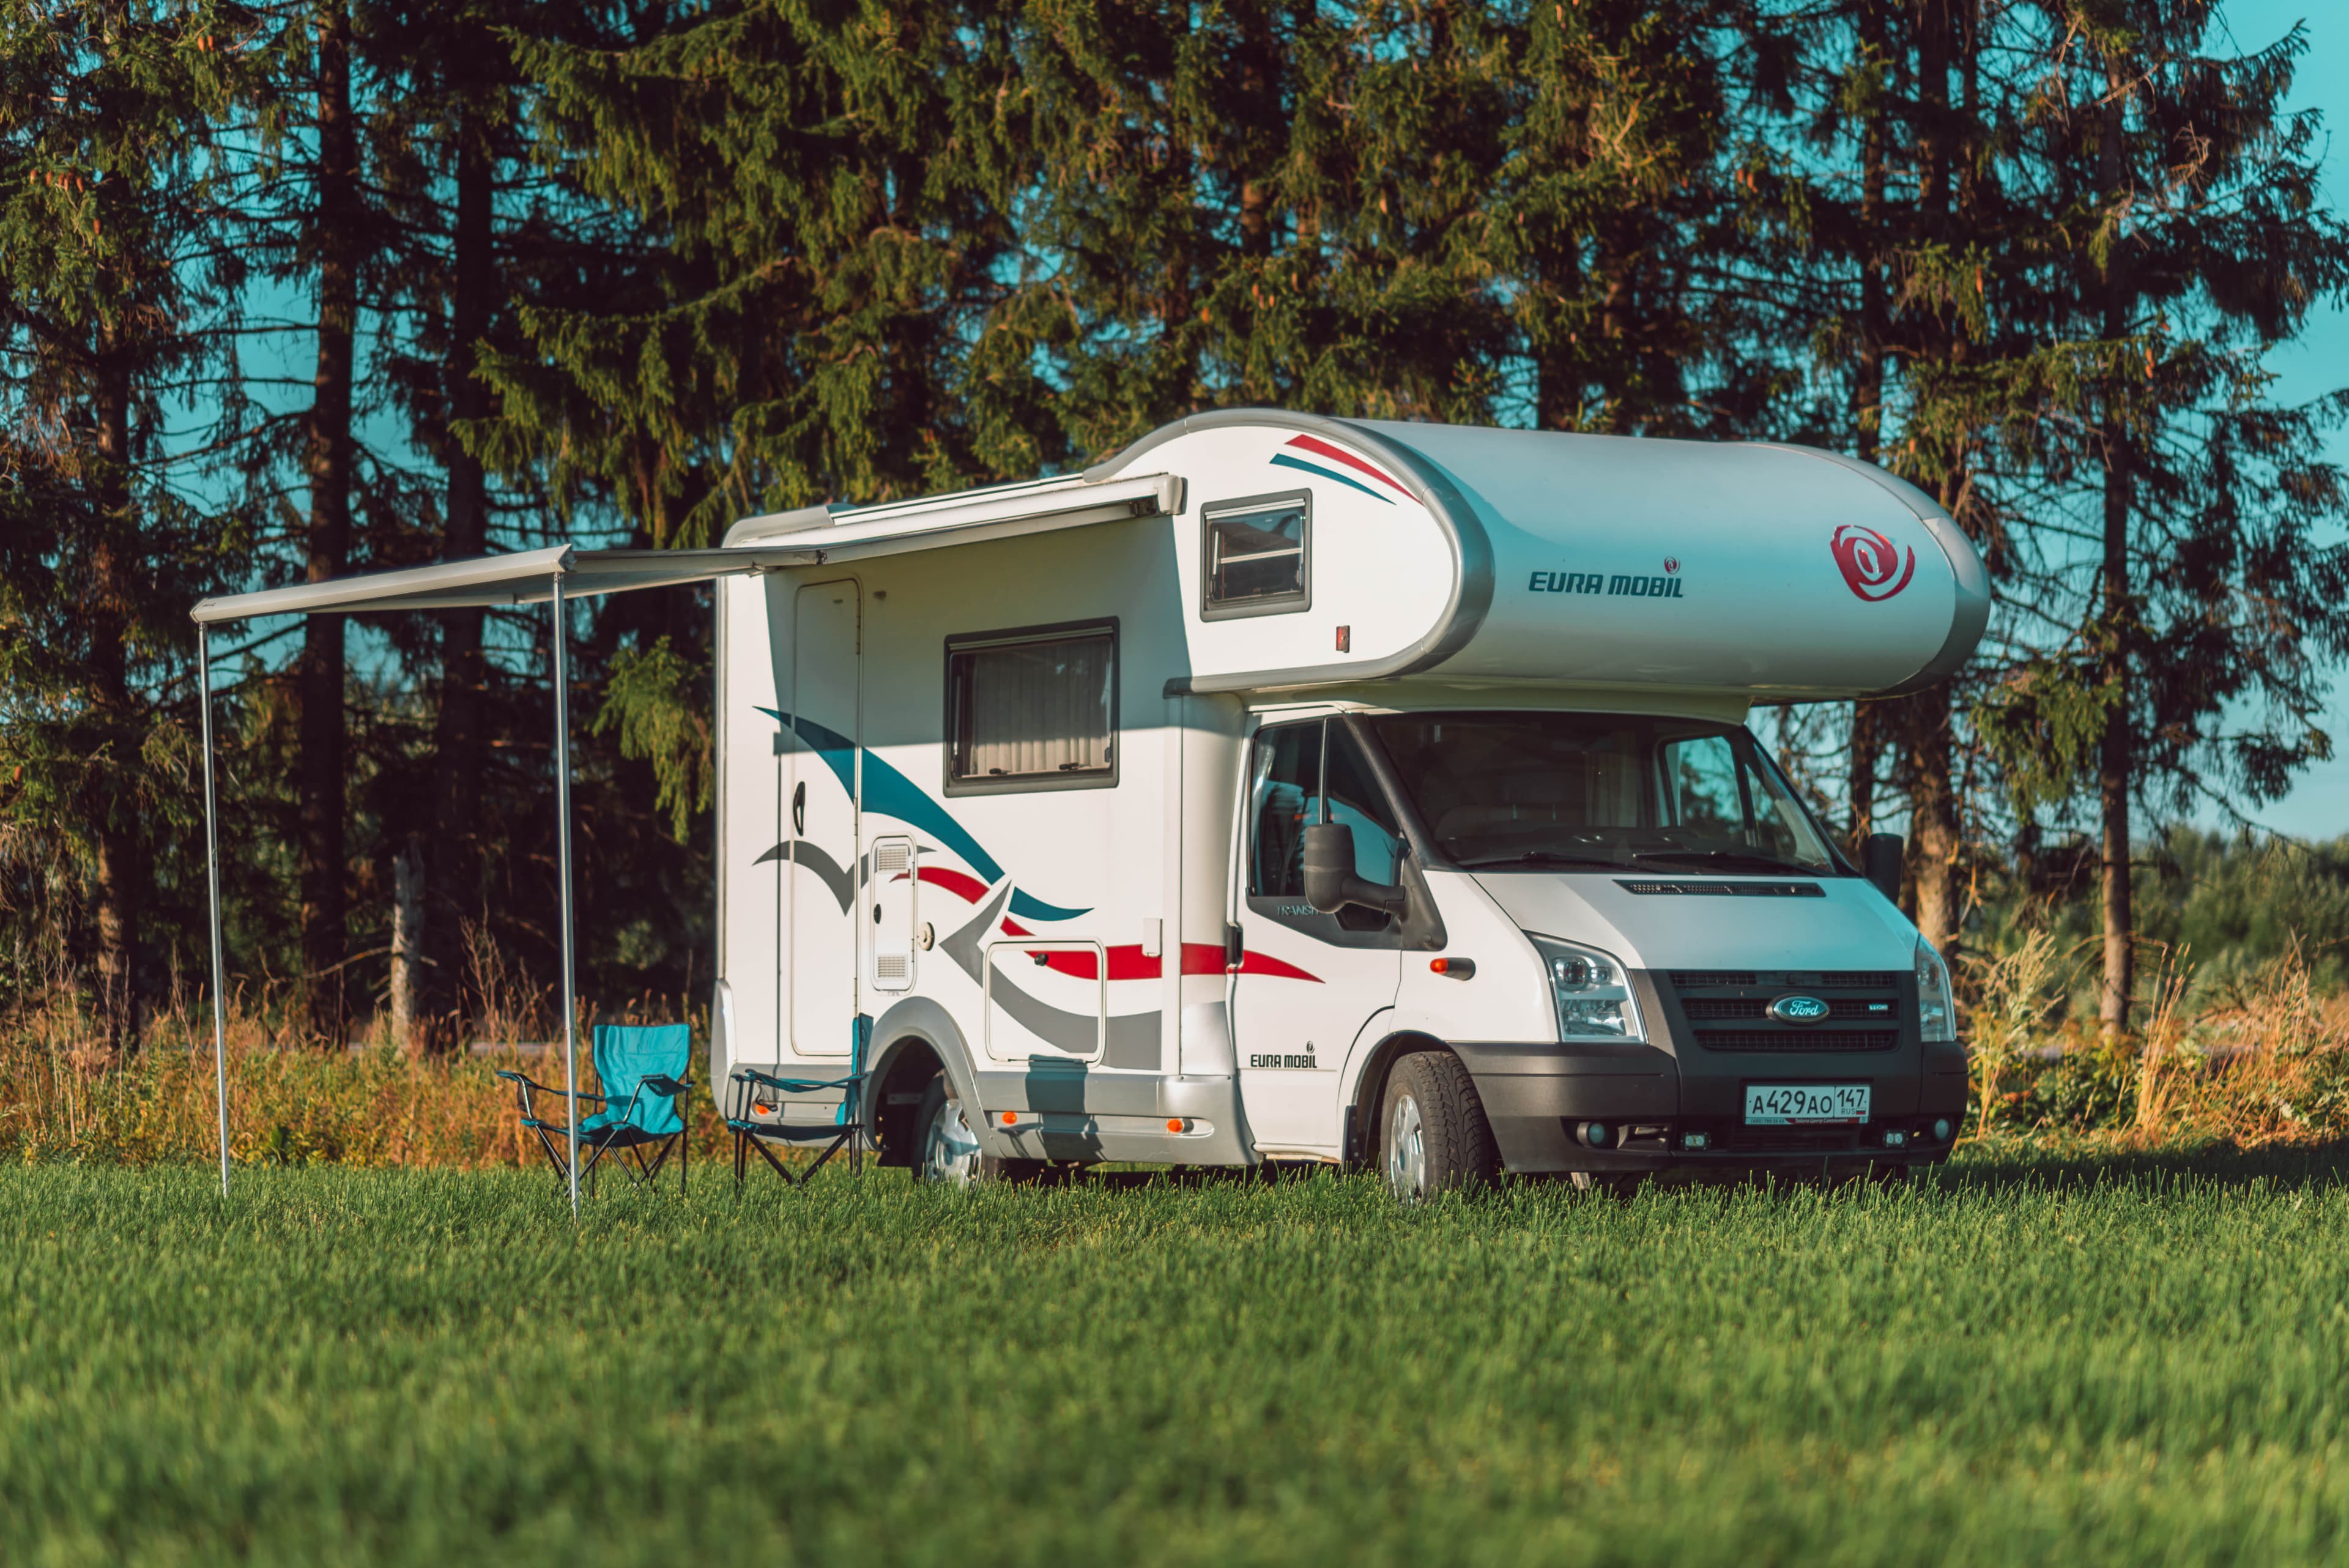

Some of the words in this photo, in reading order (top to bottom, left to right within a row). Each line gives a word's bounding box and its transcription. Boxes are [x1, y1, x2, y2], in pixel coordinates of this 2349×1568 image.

[1528, 571, 1604, 595] EURA
[1607, 574, 1683, 598] MOBIL
[1789, 1000, 1819, 1016] Ford
[1250, 1054, 1282, 1068] EURA
[1284, 1055, 1318, 1069] MOBIL
[1836, 1089, 1865, 1107] 147
